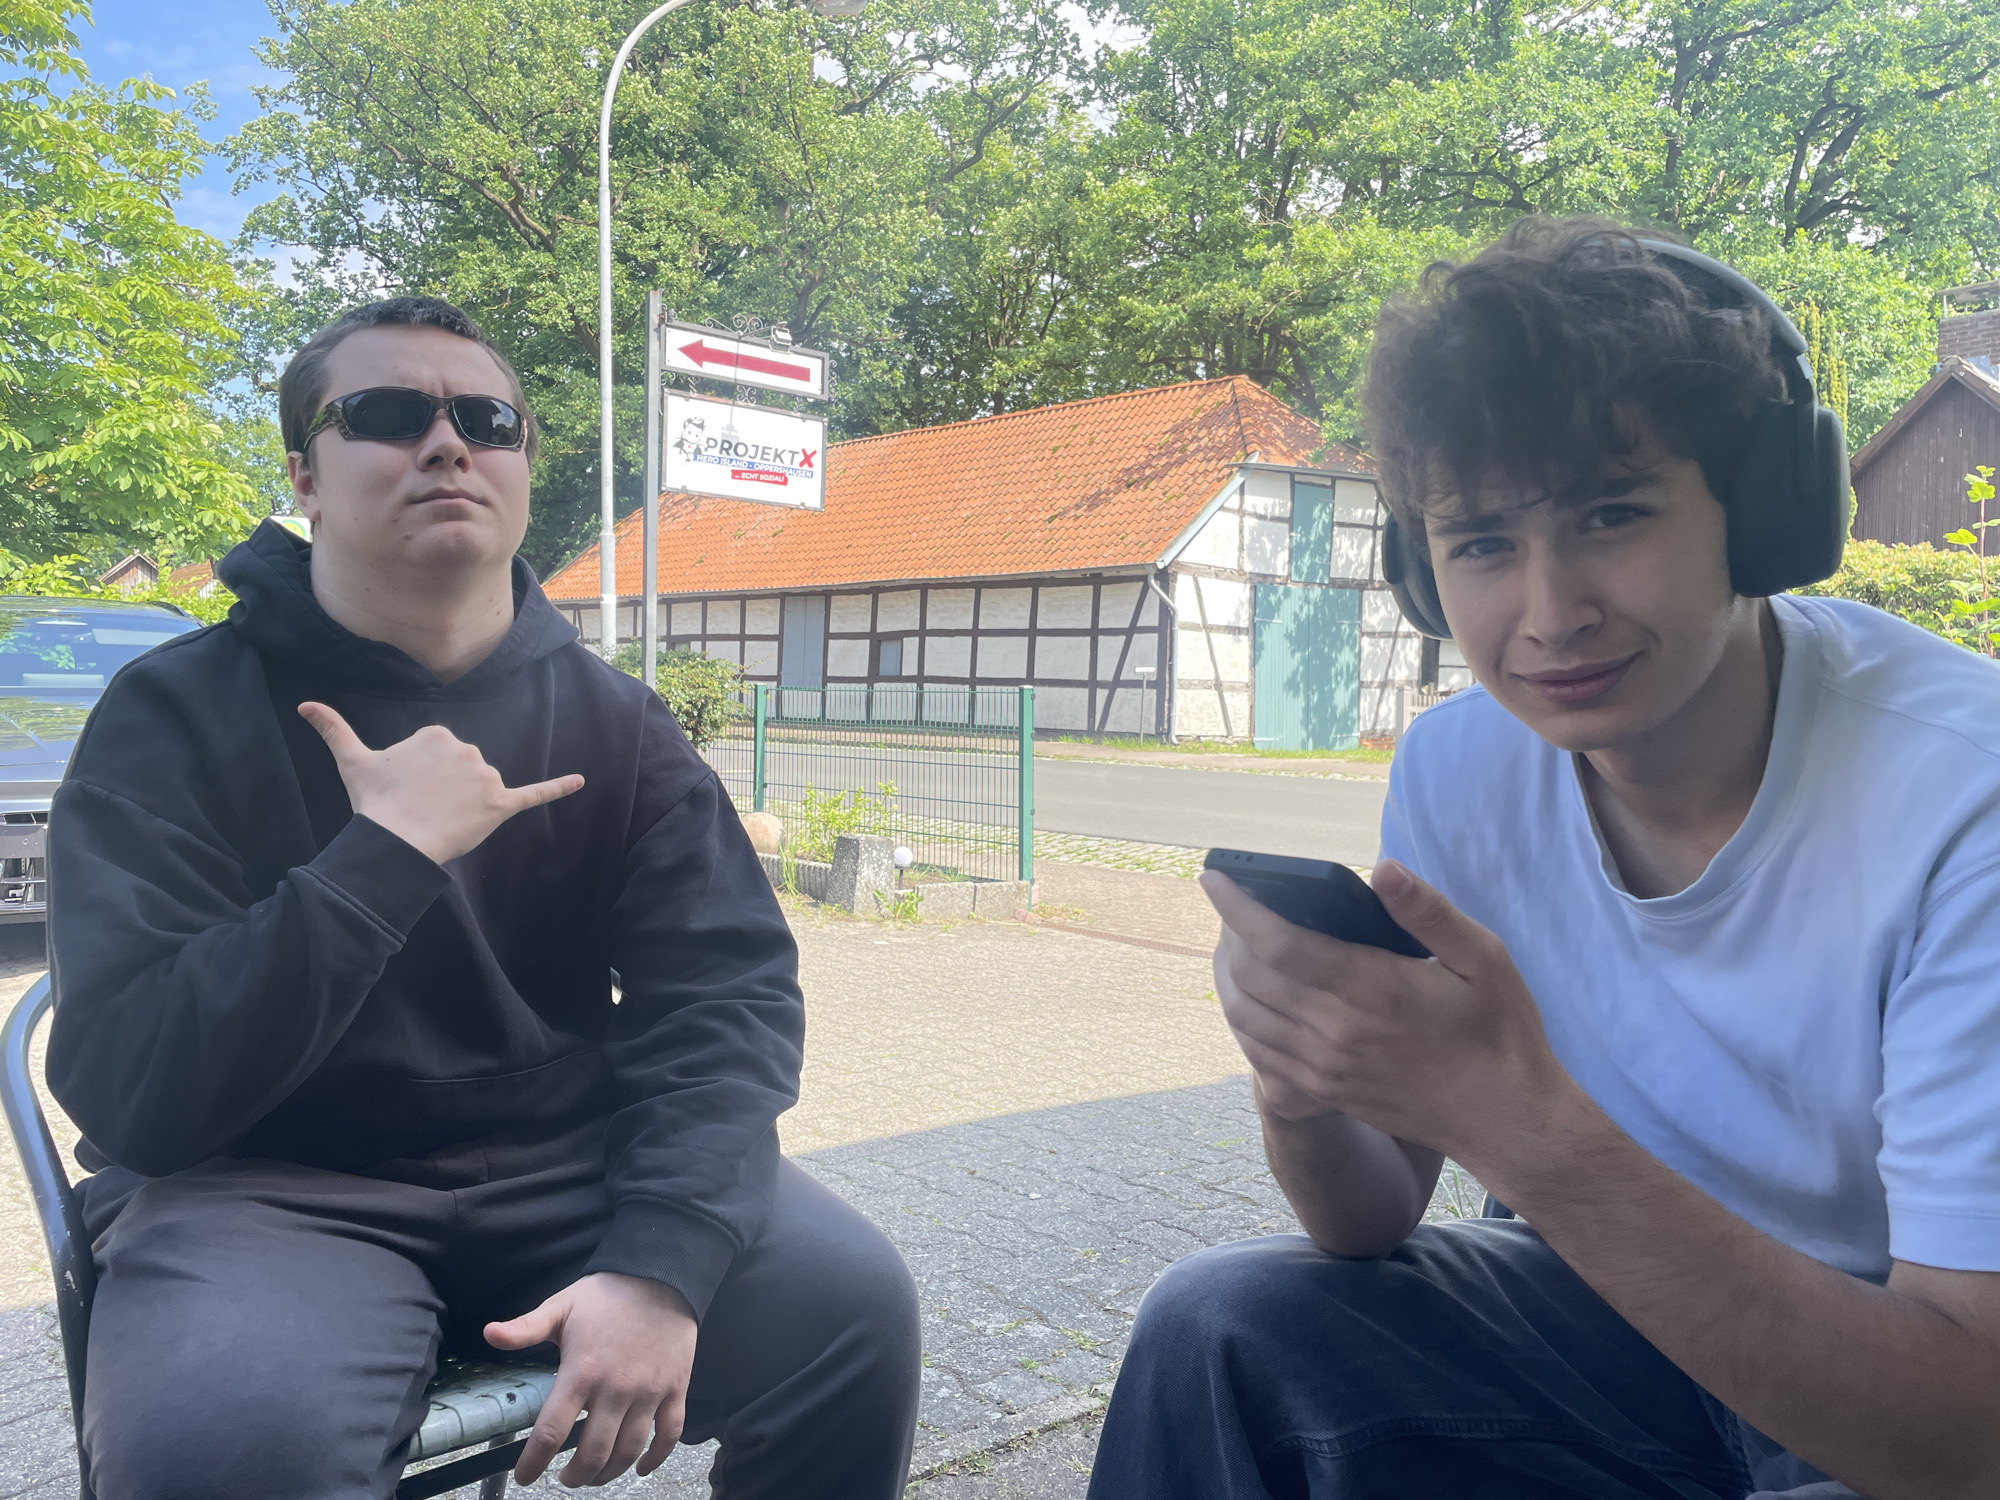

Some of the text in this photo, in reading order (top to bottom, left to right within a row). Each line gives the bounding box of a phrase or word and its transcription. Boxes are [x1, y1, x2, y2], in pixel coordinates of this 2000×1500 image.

[696, 454, 718, 464] HERO
[720, 458, 748, 469] ISLAND
[753, 463, 812, 478] OPPERSHAUSEN
[741, 472, 759, 480] ECHT
[759, 474, 785, 482] SOZIAL!
